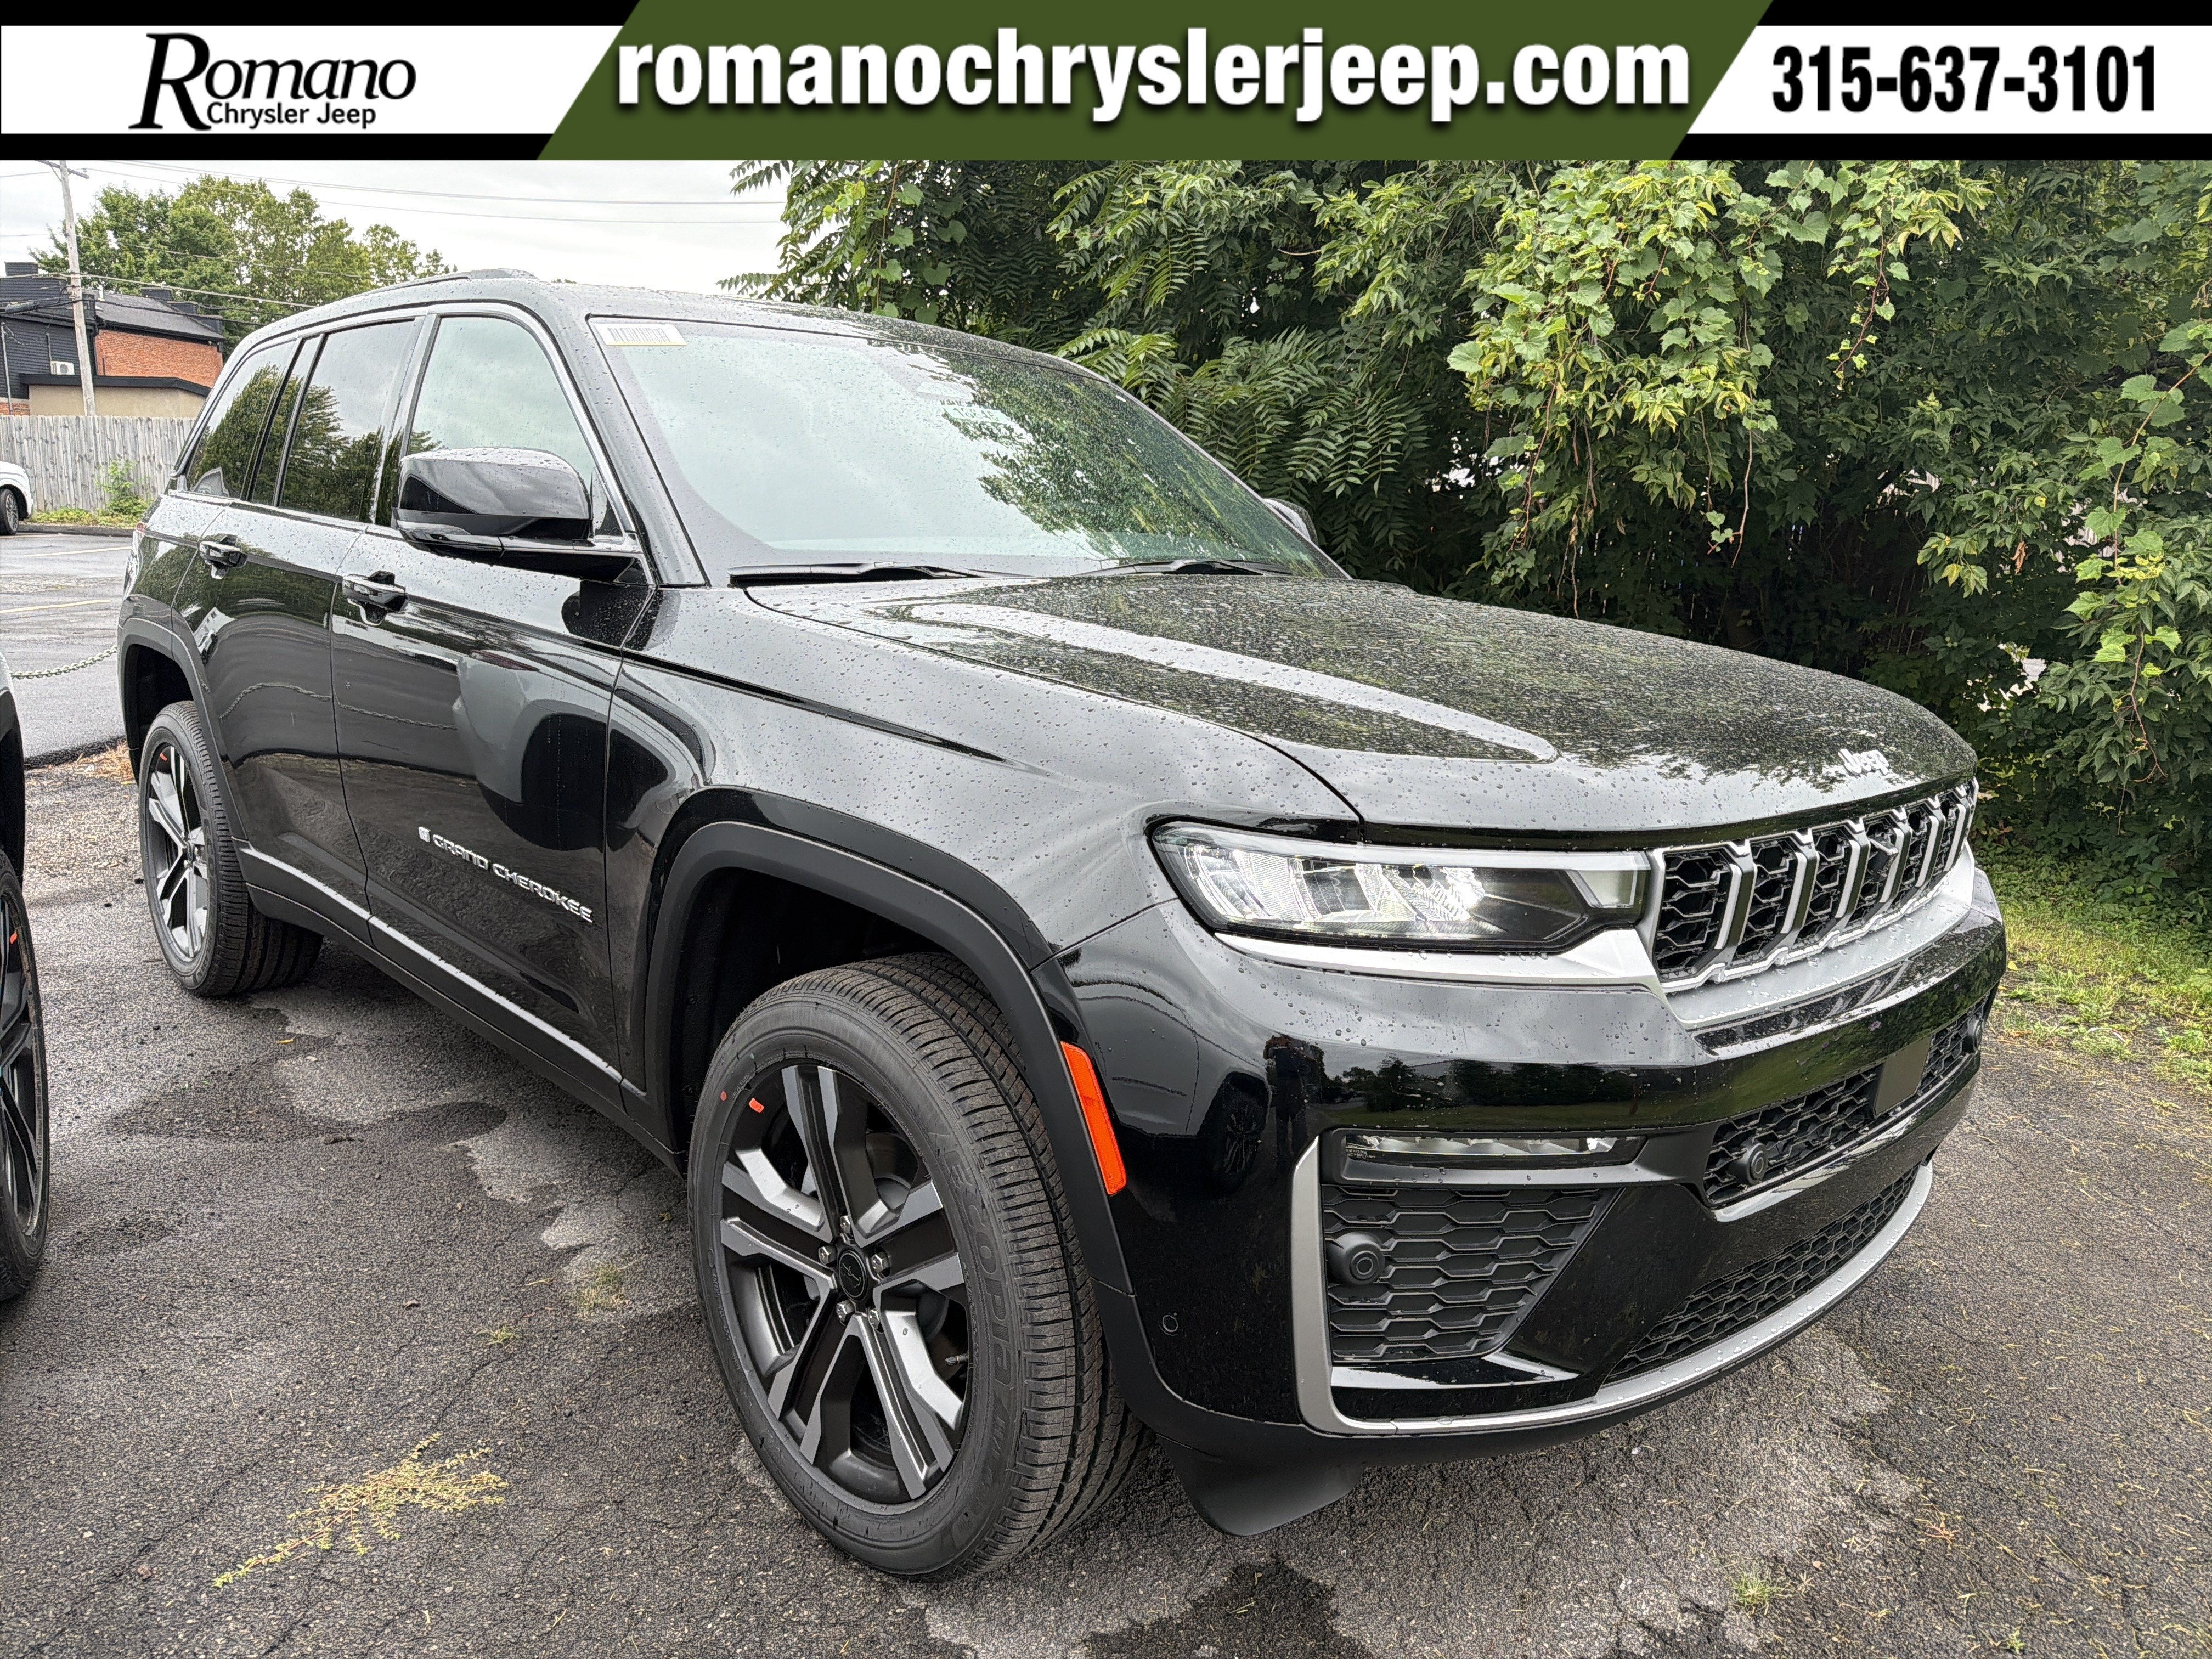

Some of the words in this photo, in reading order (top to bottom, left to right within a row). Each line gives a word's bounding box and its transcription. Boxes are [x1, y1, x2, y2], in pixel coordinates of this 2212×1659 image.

[1838, 748, 1890, 775] Jeep
[432, 834, 490, 870] GRAND
[492, 862, 596, 924] CHEROKEE
